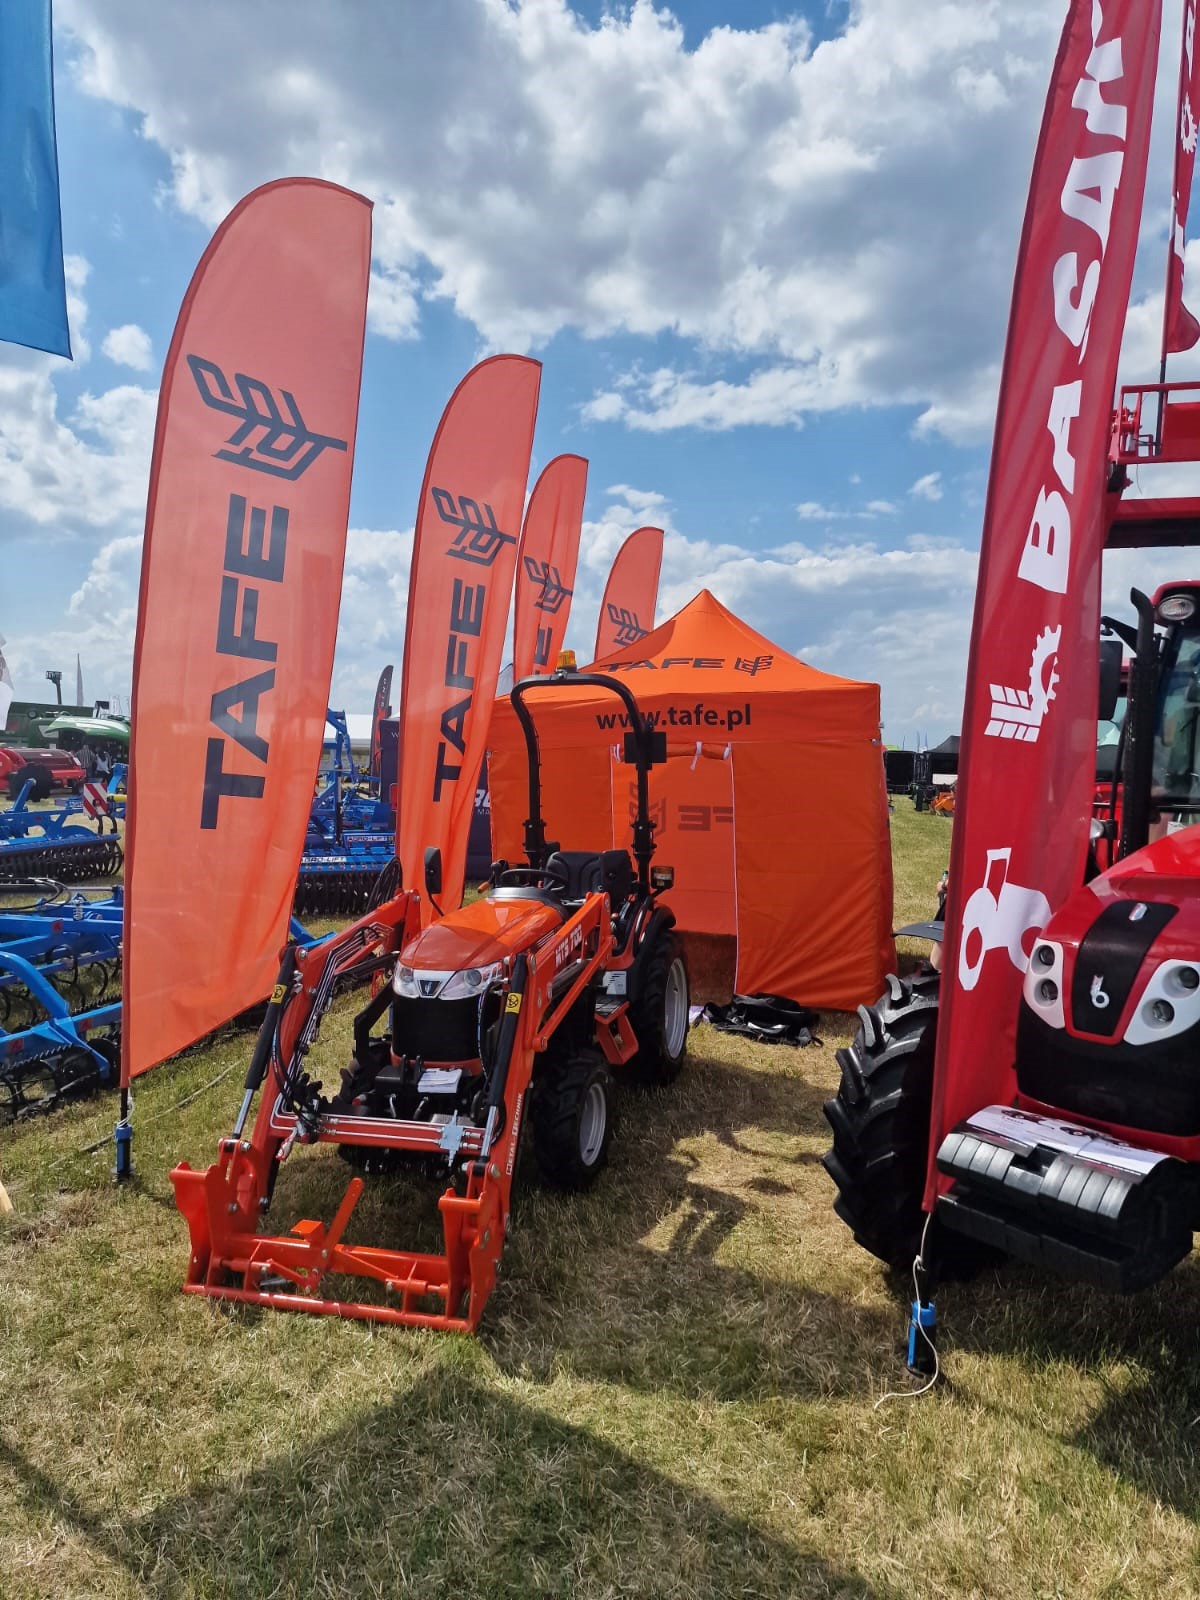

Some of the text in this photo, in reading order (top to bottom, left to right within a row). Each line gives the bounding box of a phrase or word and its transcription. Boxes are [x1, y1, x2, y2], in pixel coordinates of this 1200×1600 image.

[200, 493, 290, 830] TAFE
[432, 577, 486, 803] TAFE
[596, 703, 752, 731] www.tafe.pl
[600, 656, 726, 673] TAFE
